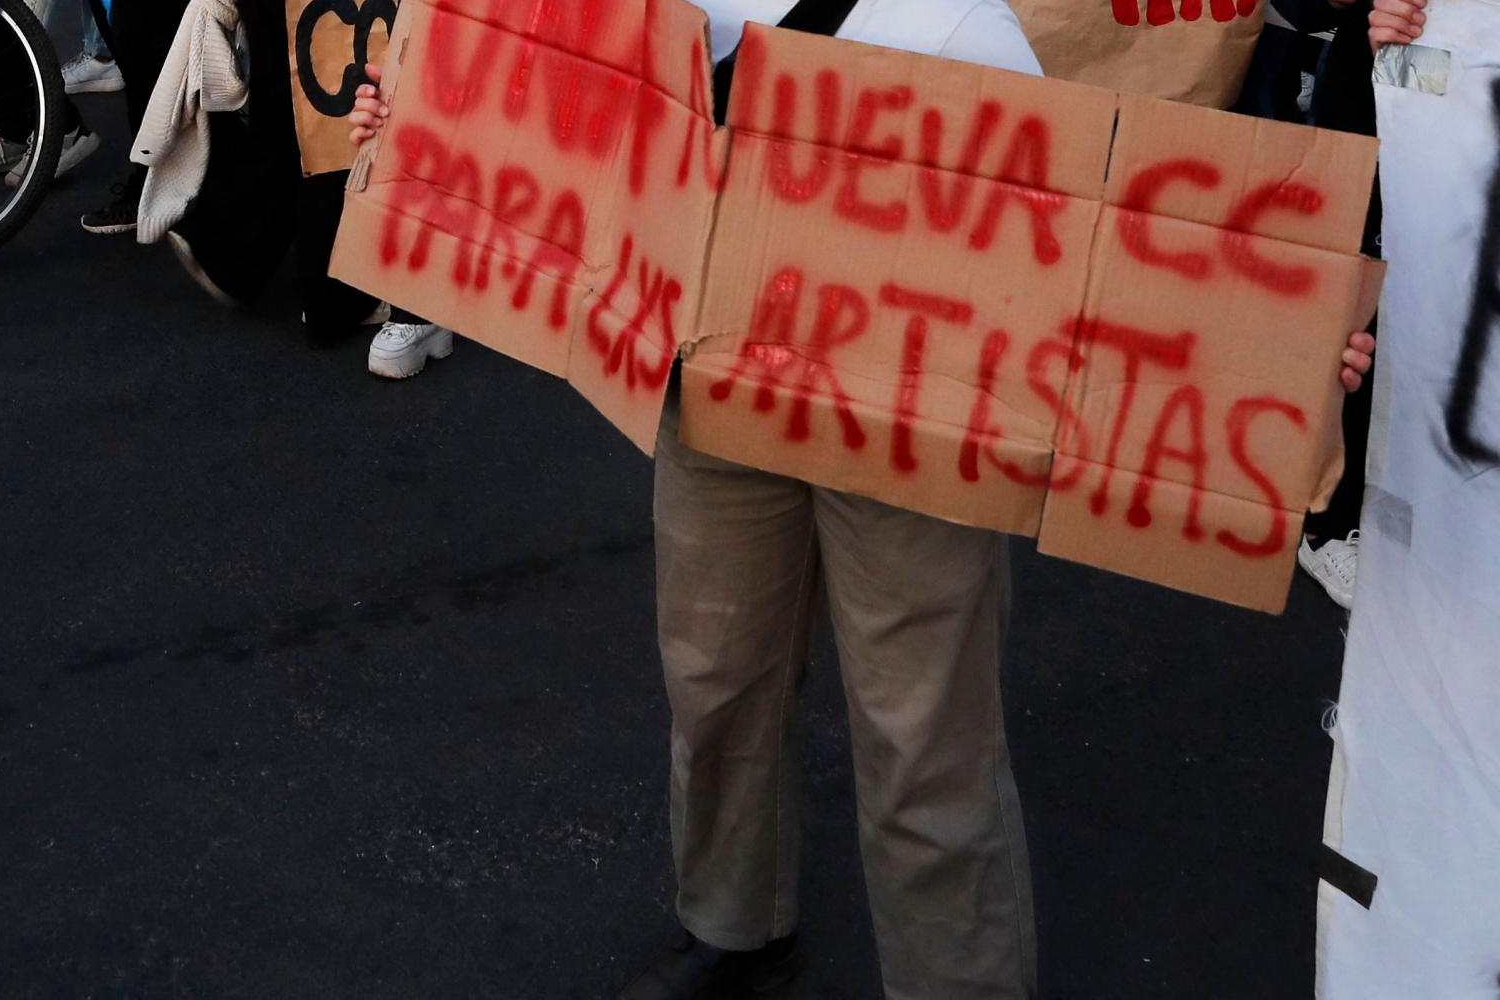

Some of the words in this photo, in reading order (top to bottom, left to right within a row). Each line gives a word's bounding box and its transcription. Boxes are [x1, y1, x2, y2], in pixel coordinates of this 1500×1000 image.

[377, 122, 590, 332] PARA
[707, 264, 1311, 560] ARTISTAS
[1115, 154, 1329, 300] CC
